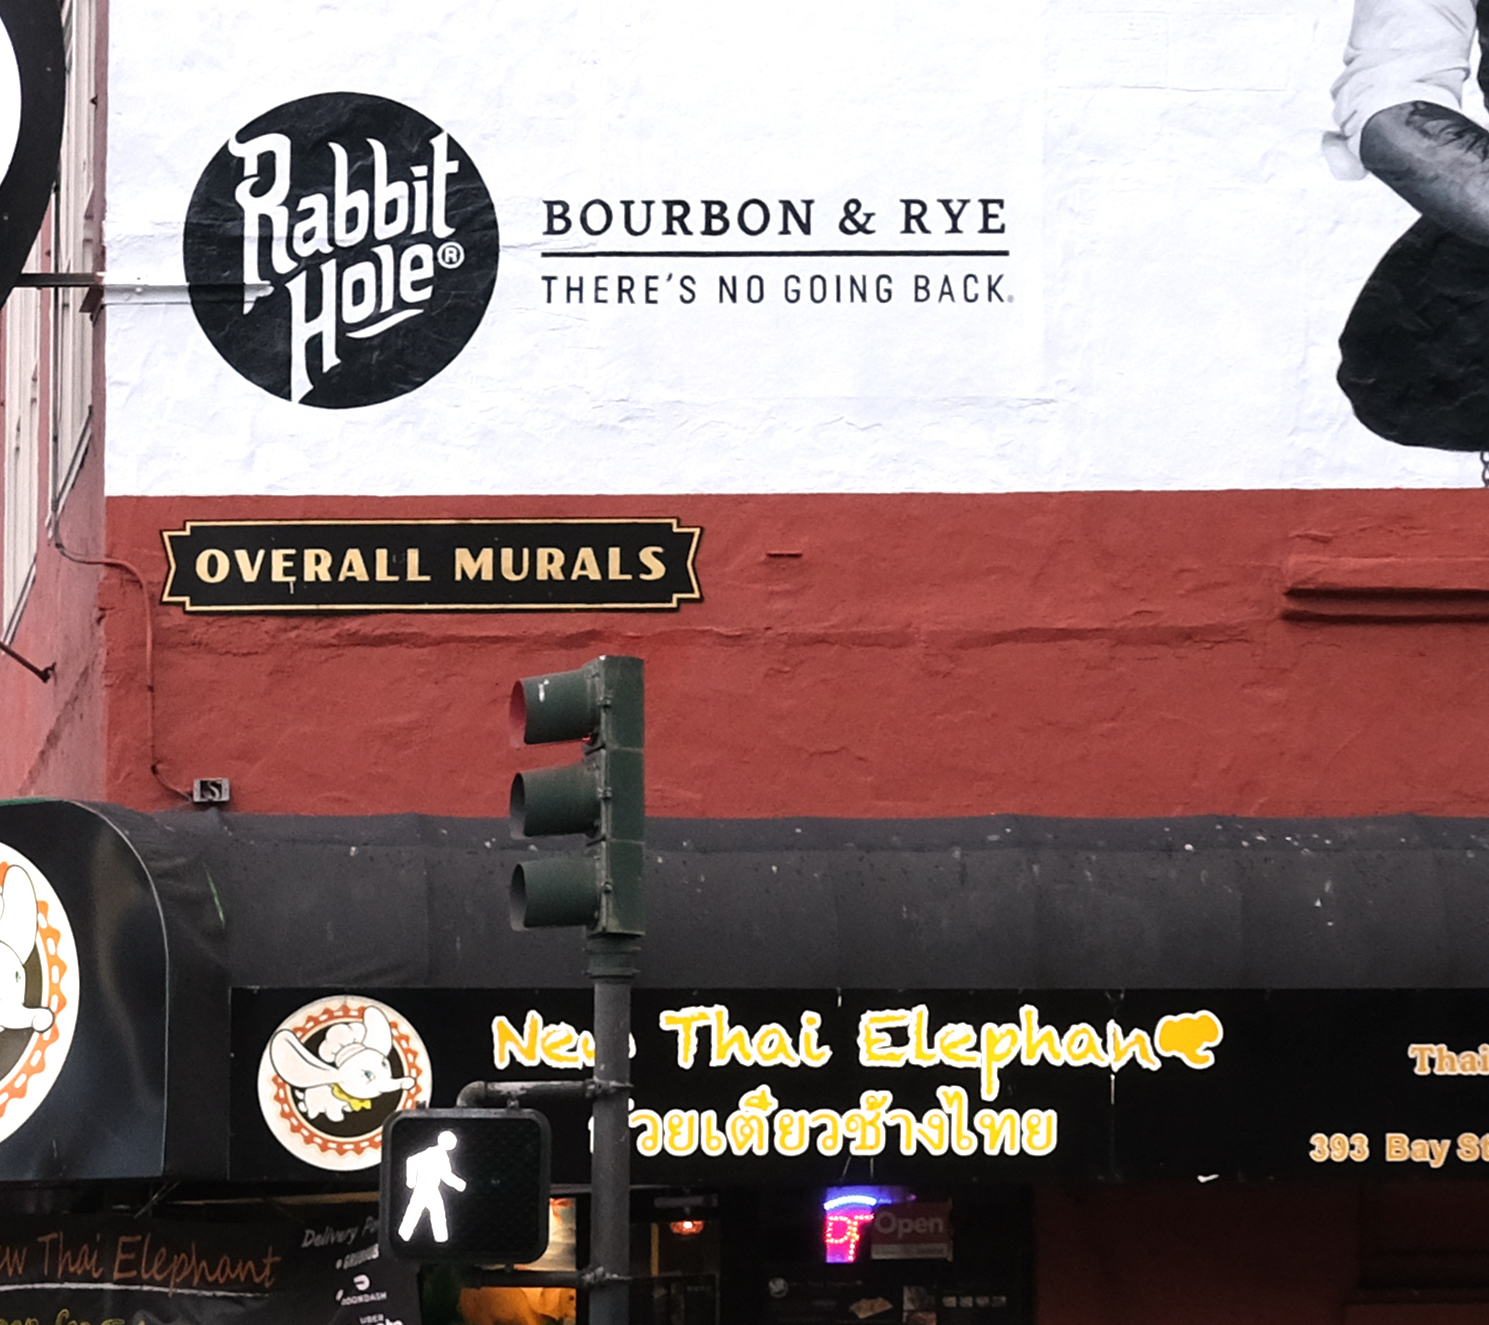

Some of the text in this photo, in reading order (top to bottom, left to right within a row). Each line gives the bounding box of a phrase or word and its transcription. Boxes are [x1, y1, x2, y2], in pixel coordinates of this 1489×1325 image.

[227, 128, 460, 313] Rabbit
[542, 198, 1006, 237] BOURBON & RYE
[541, 273, 697, 305] THERE'S
[718, 274, 765, 304] NO
[784, 273, 893, 304] GOING
[195, 546, 666, 585] OVERALL MURALS
[659, 1004, 832, 1070] Thai
[1308, 1132, 1370, 1163] 393
[1385, 1132, 1452, 1169] Bay
[874, 1211, 944, 1239] Open
[37, 1231, 103, 1279] Thai
[113, 1232, 281, 1298] Elephant
